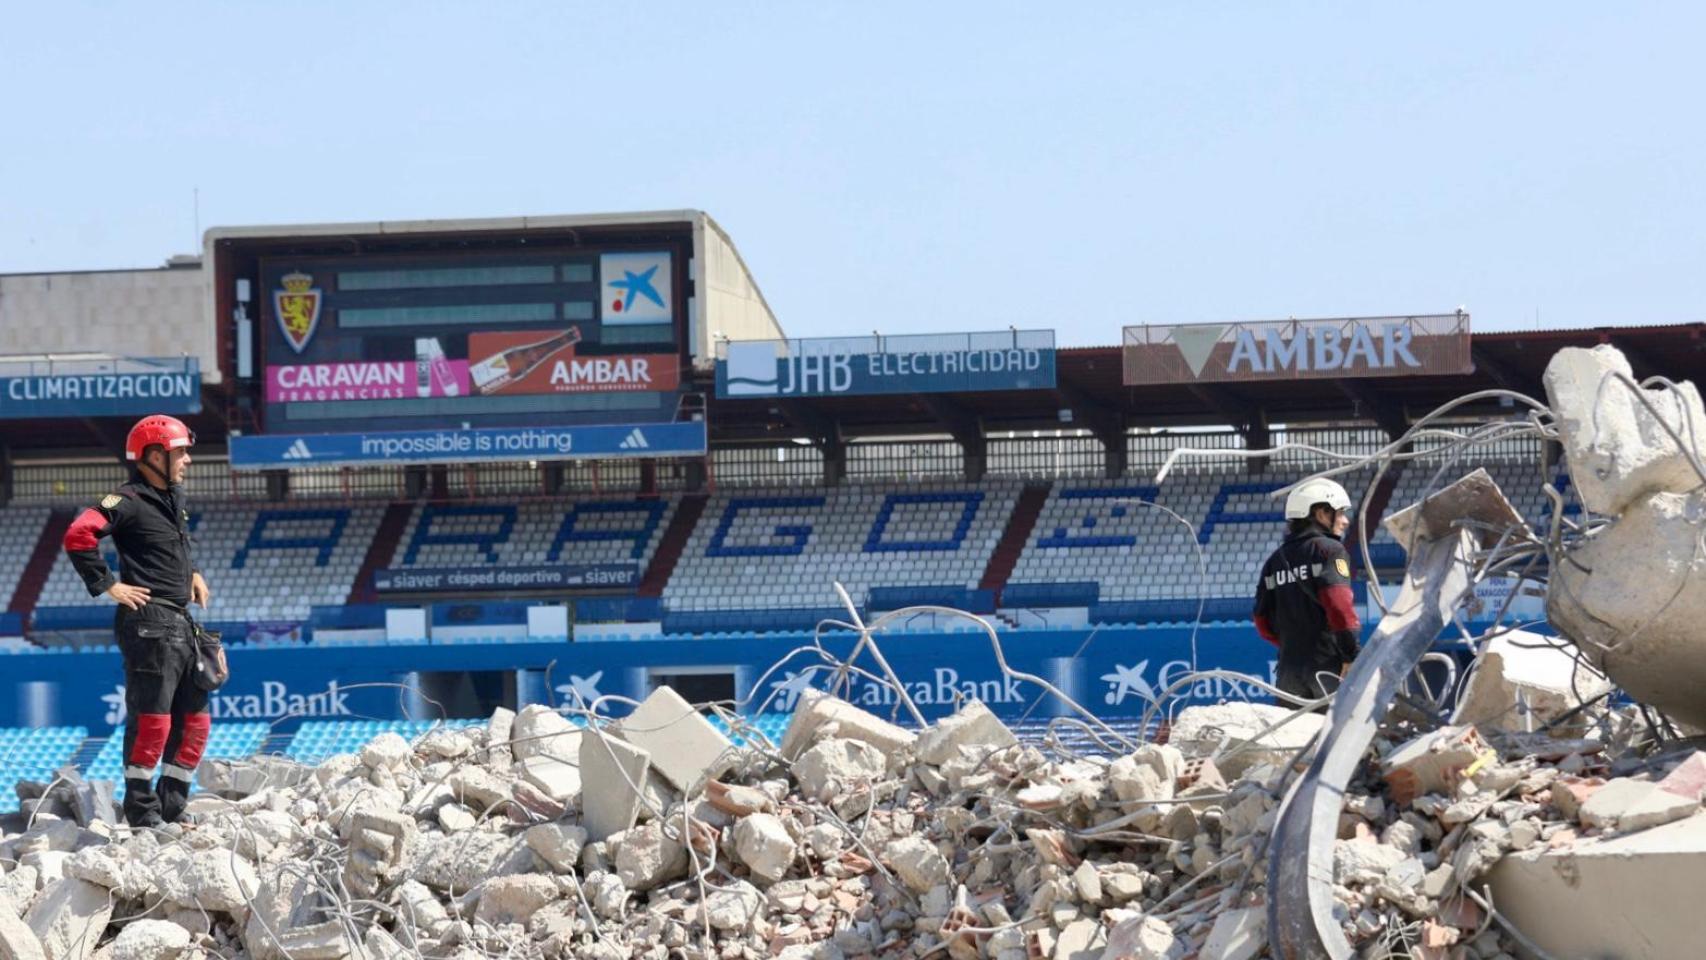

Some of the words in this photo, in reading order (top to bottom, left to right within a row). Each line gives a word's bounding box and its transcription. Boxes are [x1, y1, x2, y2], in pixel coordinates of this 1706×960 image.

[1226, 323, 1421, 373] AMBAR
[277, 363, 405, 388] CARAVAN
[550, 359, 652, 384] AMBAR
[868, 350, 1040, 376] ELECTRICIDAD
[9, 371, 192, 400] CLIMATIZACIÓN
[279, 388, 404, 402] FRAGANCIAS
[362, 434, 471, 457] impossible
[475, 432, 491, 450] is
[495, 430, 572, 452] nothing
[394, 573, 442, 588] siaver
[448, 571, 494, 587] césped
[497, 570, 562, 586] deportivo
[585, 569, 634, 584] siaver
